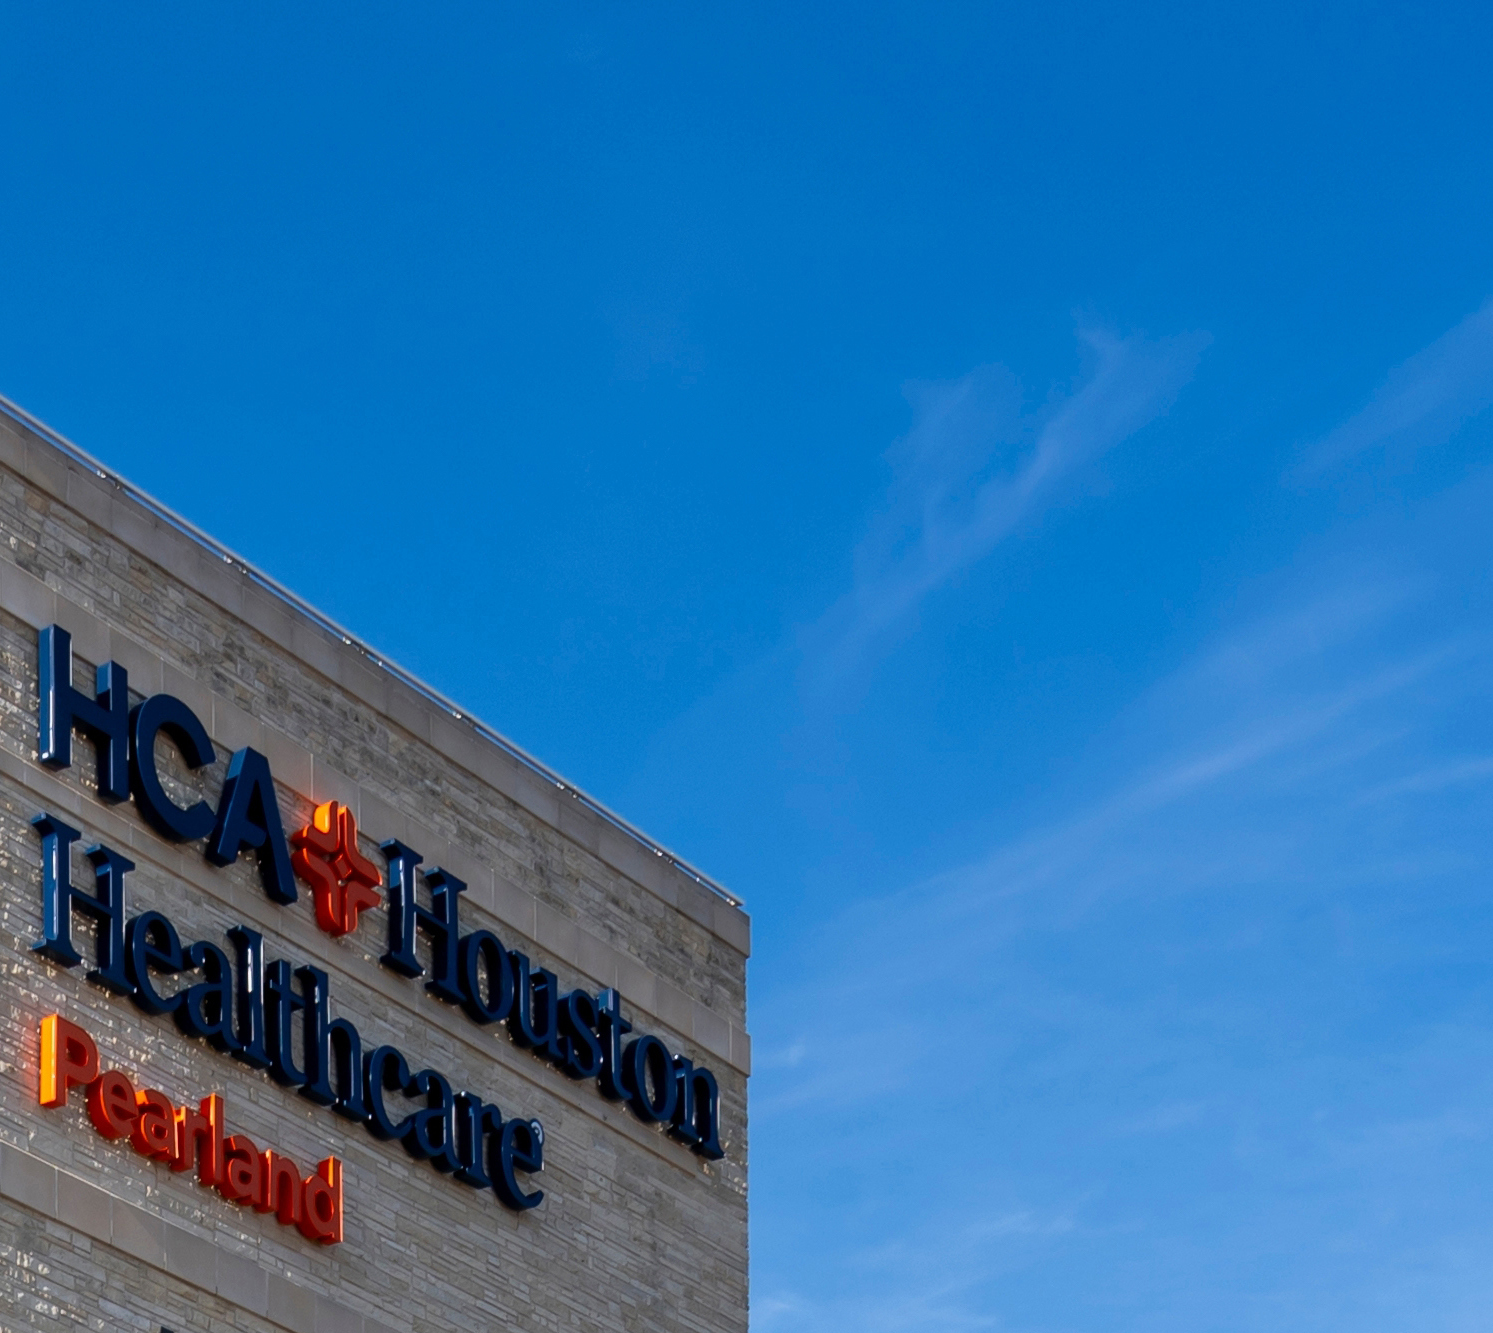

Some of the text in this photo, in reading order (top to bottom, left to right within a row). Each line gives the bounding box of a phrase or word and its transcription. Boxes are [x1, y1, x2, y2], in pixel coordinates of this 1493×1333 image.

[31, 812, 546, 1211] Healthcare
[38, 623, 724, 1160] HCA Houston
[39, 1013, 343, 1245] Pearland
